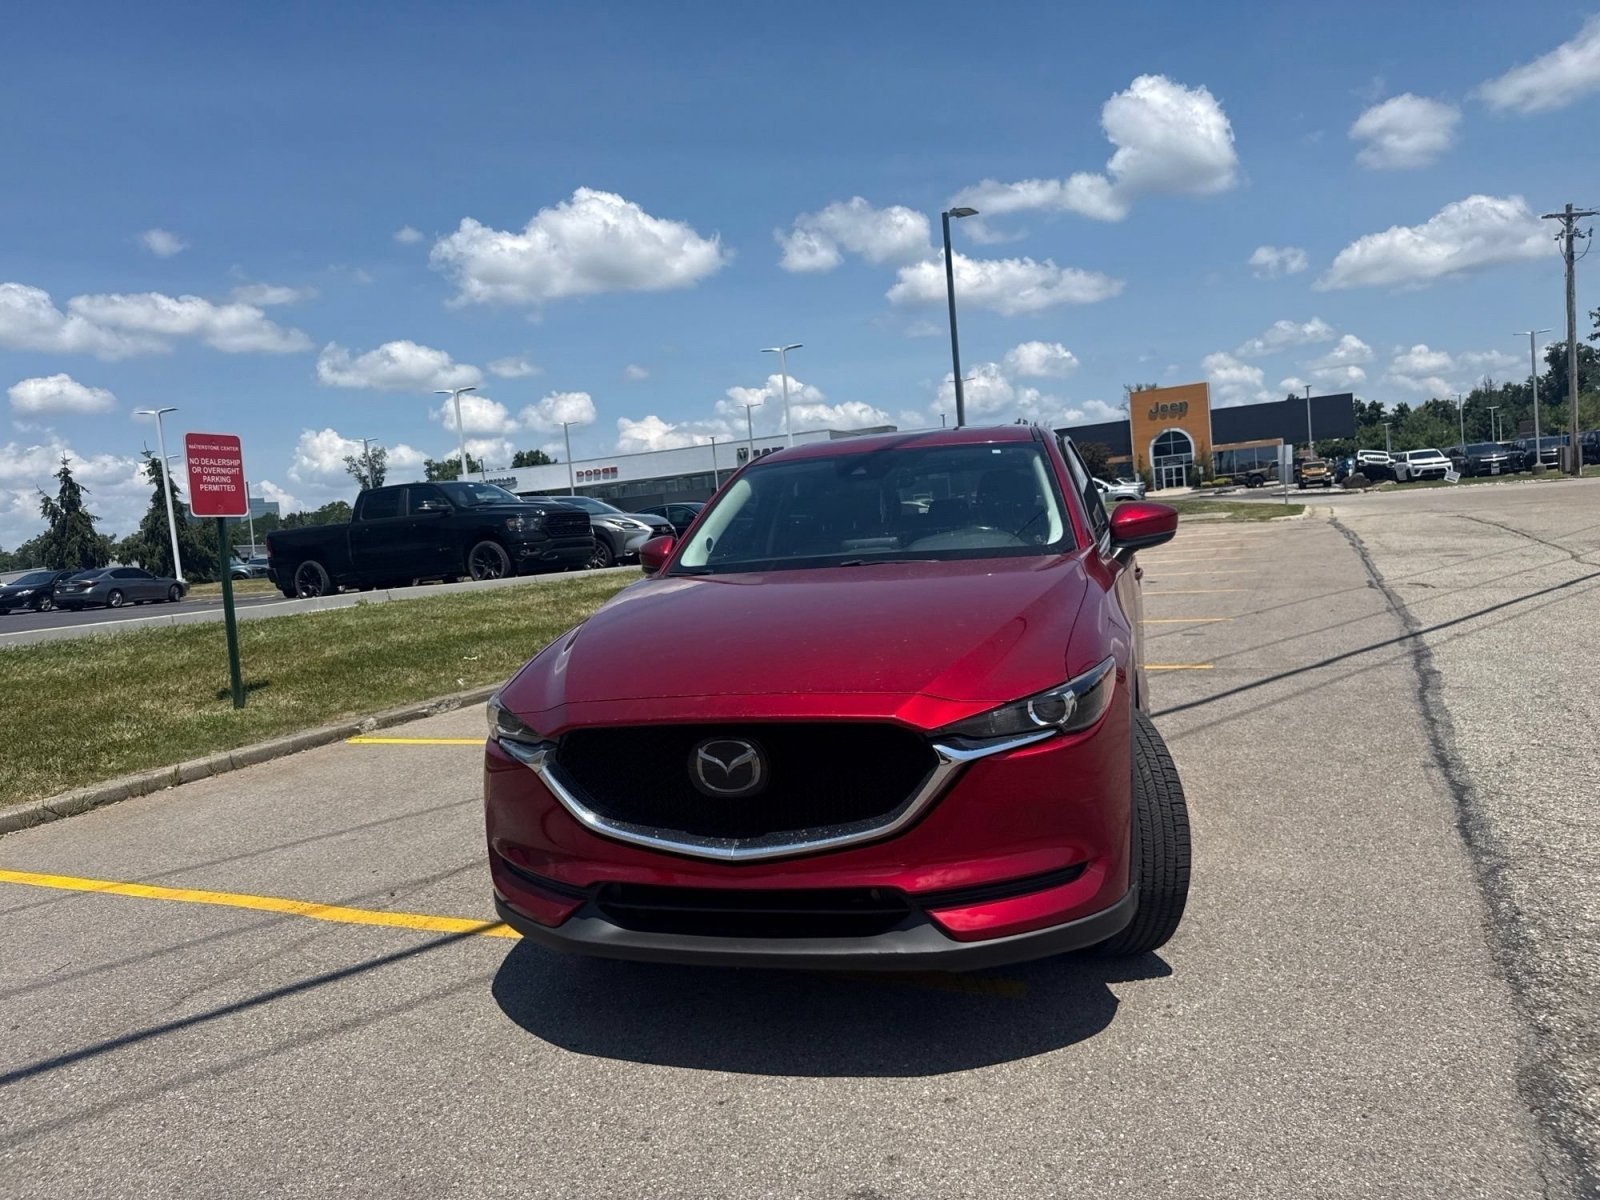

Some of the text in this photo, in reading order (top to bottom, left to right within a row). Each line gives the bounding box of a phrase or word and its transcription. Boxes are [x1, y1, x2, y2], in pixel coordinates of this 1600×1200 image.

[1149, 401, 1188, 414] Jeep
[201, 458, 240, 466] DEALERSHIP
[203, 467, 240, 475] OVERNIGHT
[576, 466, 618, 477] DODGE
[200, 484, 236, 492] PERMITTED
